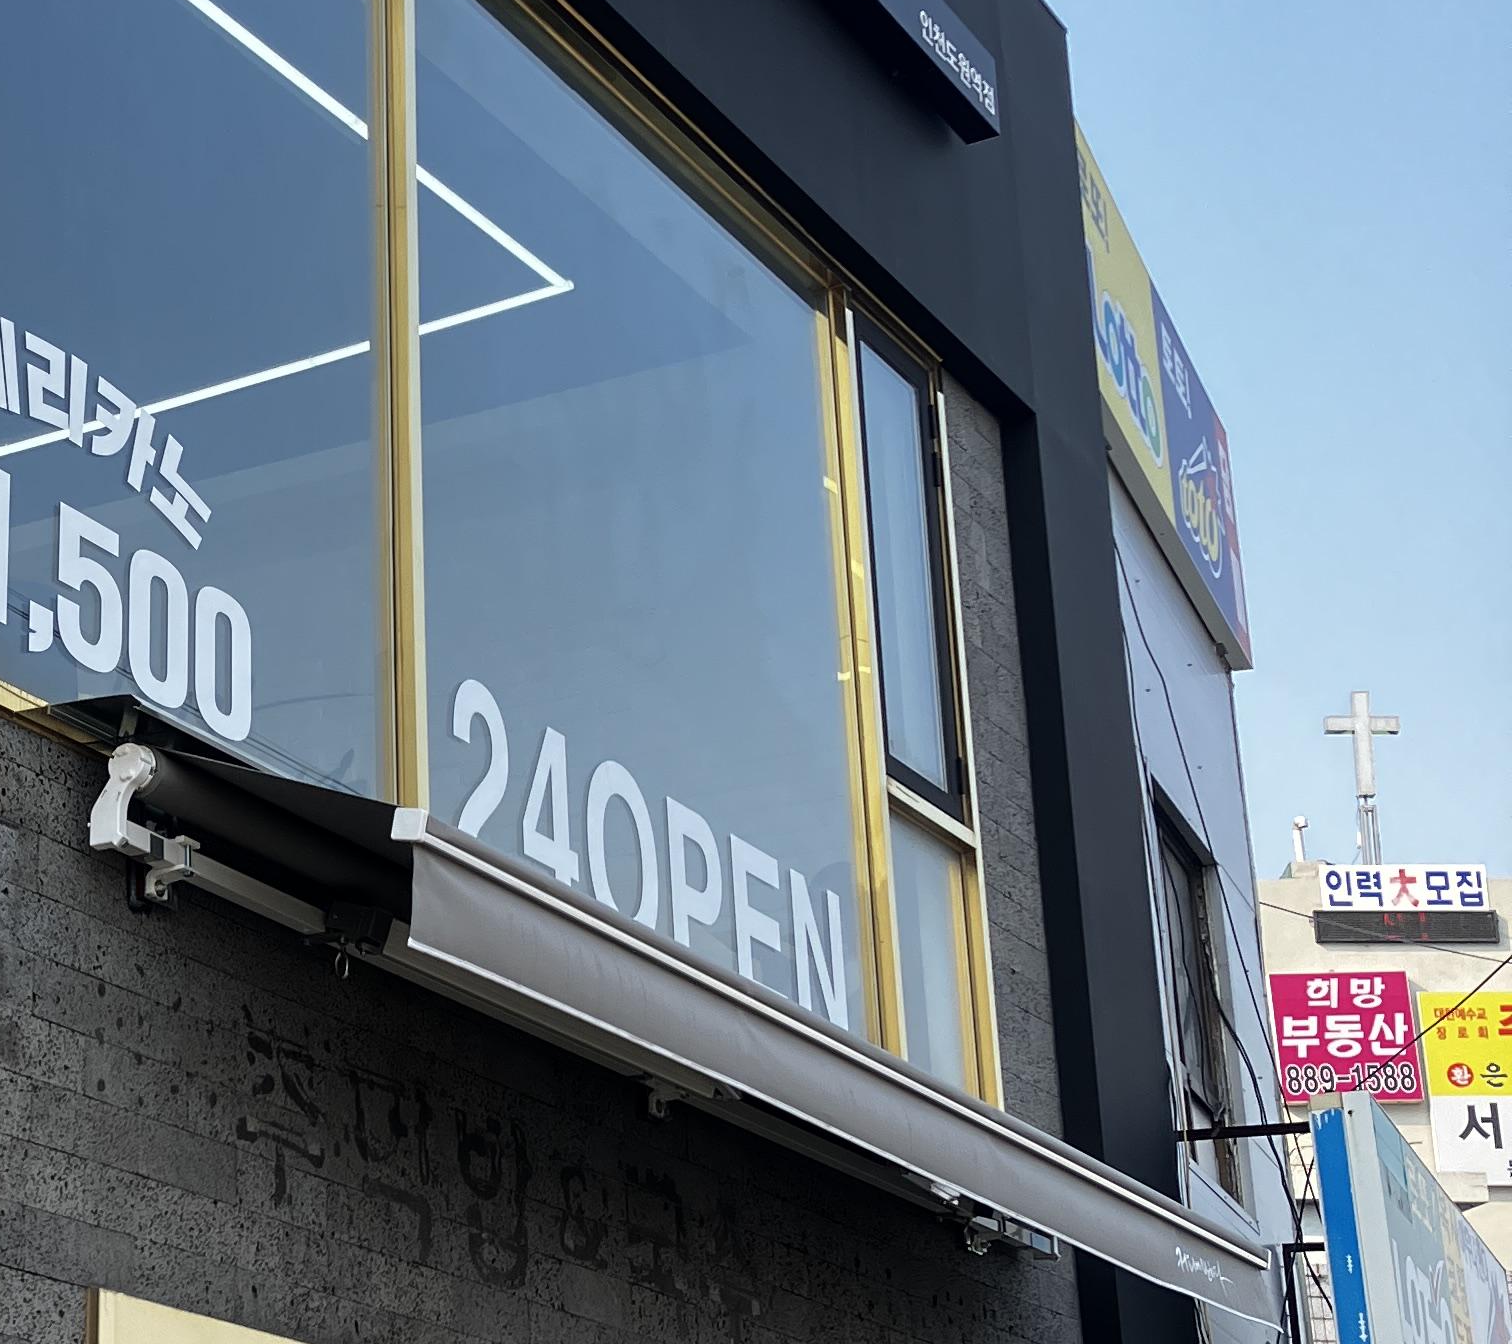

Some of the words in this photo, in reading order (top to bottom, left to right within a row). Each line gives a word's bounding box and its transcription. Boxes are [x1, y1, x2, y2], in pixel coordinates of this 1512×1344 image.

[1305, 976, 1386, 1009] 희망
[1281, 1012, 1409, 1058] 부동산
[1286, 1062, 1416, 1095] 889-1588
[1458, 1102, 1503, 1150] 서
